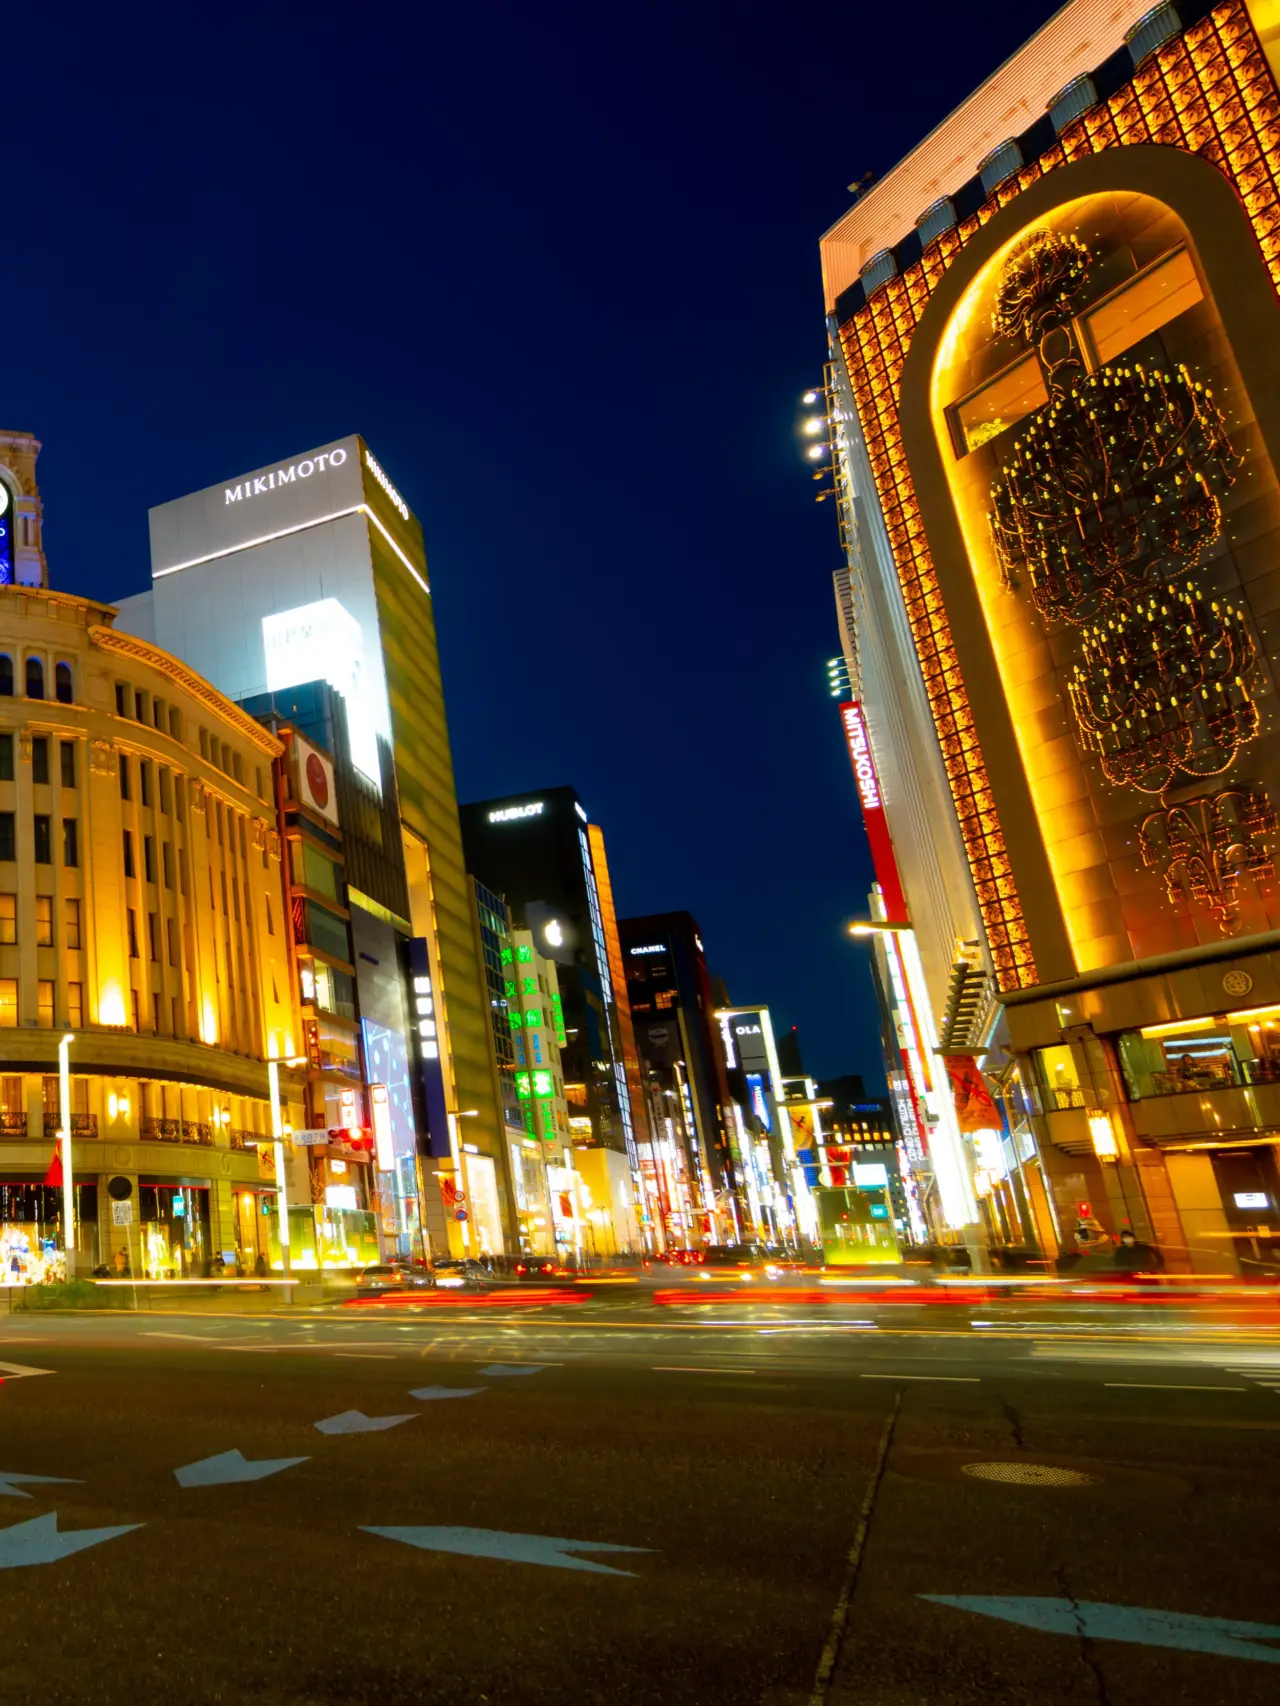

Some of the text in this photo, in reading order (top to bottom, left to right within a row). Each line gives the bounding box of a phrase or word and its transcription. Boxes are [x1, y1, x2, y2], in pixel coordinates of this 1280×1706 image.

[225, 449, 347, 505] MIKIMOTO
[843, 707, 880, 809] MITSUKOSHI
[489, 802, 544, 823] HUBLOT
[630, 944, 667, 955] CHANEL
